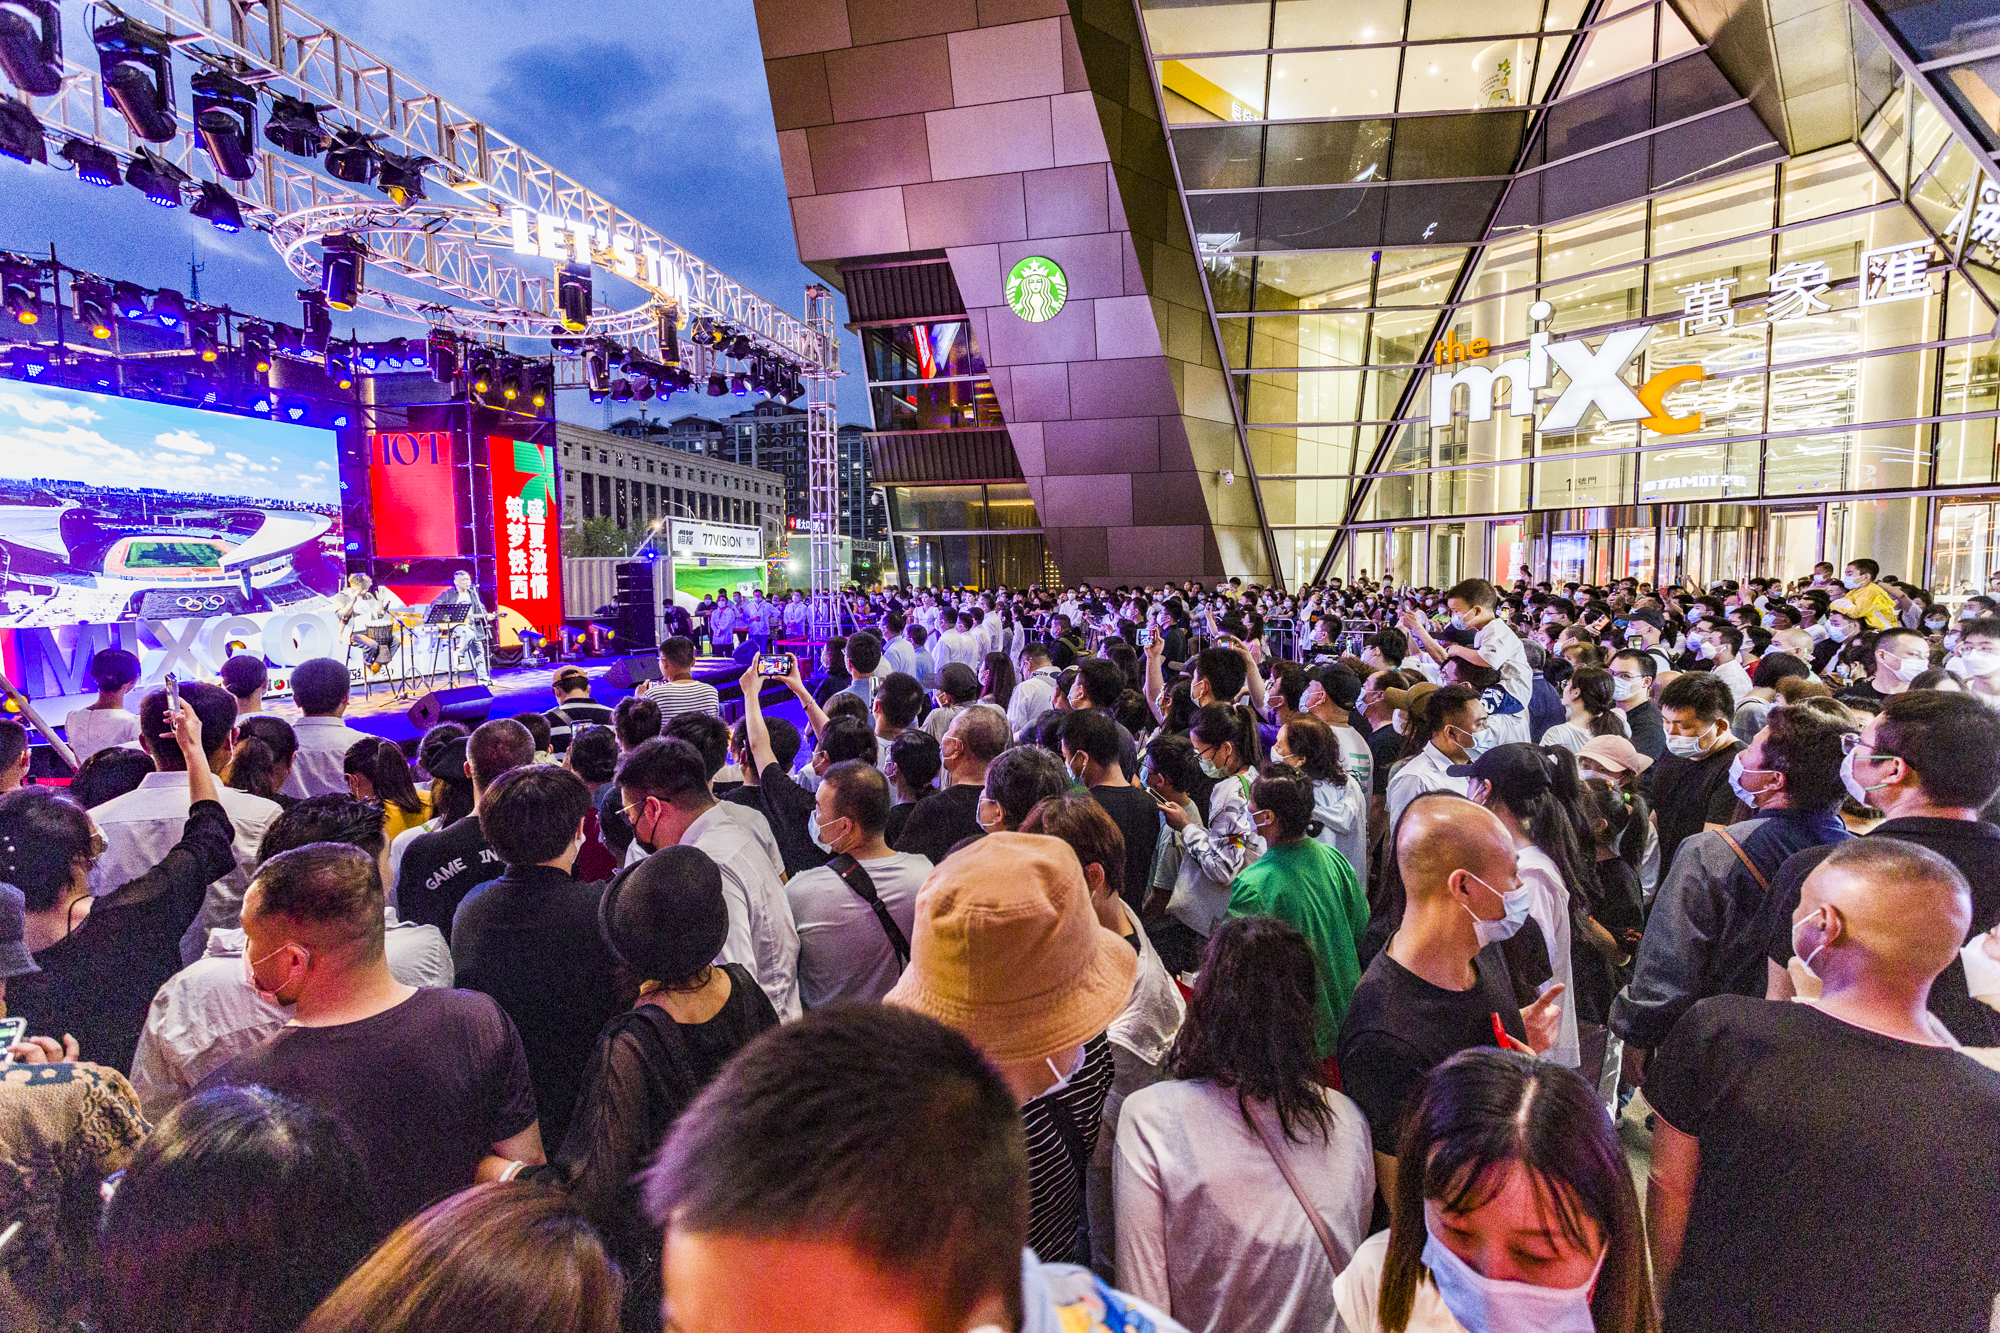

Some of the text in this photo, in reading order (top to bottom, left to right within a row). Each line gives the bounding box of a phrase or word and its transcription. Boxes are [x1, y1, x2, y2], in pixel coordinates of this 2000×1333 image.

[1678, 237, 1935, 338] 萬象匯
[1434, 330, 1490, 366] the
[505, 495, 529, 600] 筑梦铁西
[526, 498, 549, 599] 盛夏激情
[702, 533, 742, 548] 77VISION
[425, 857, 467, 890] GAME
